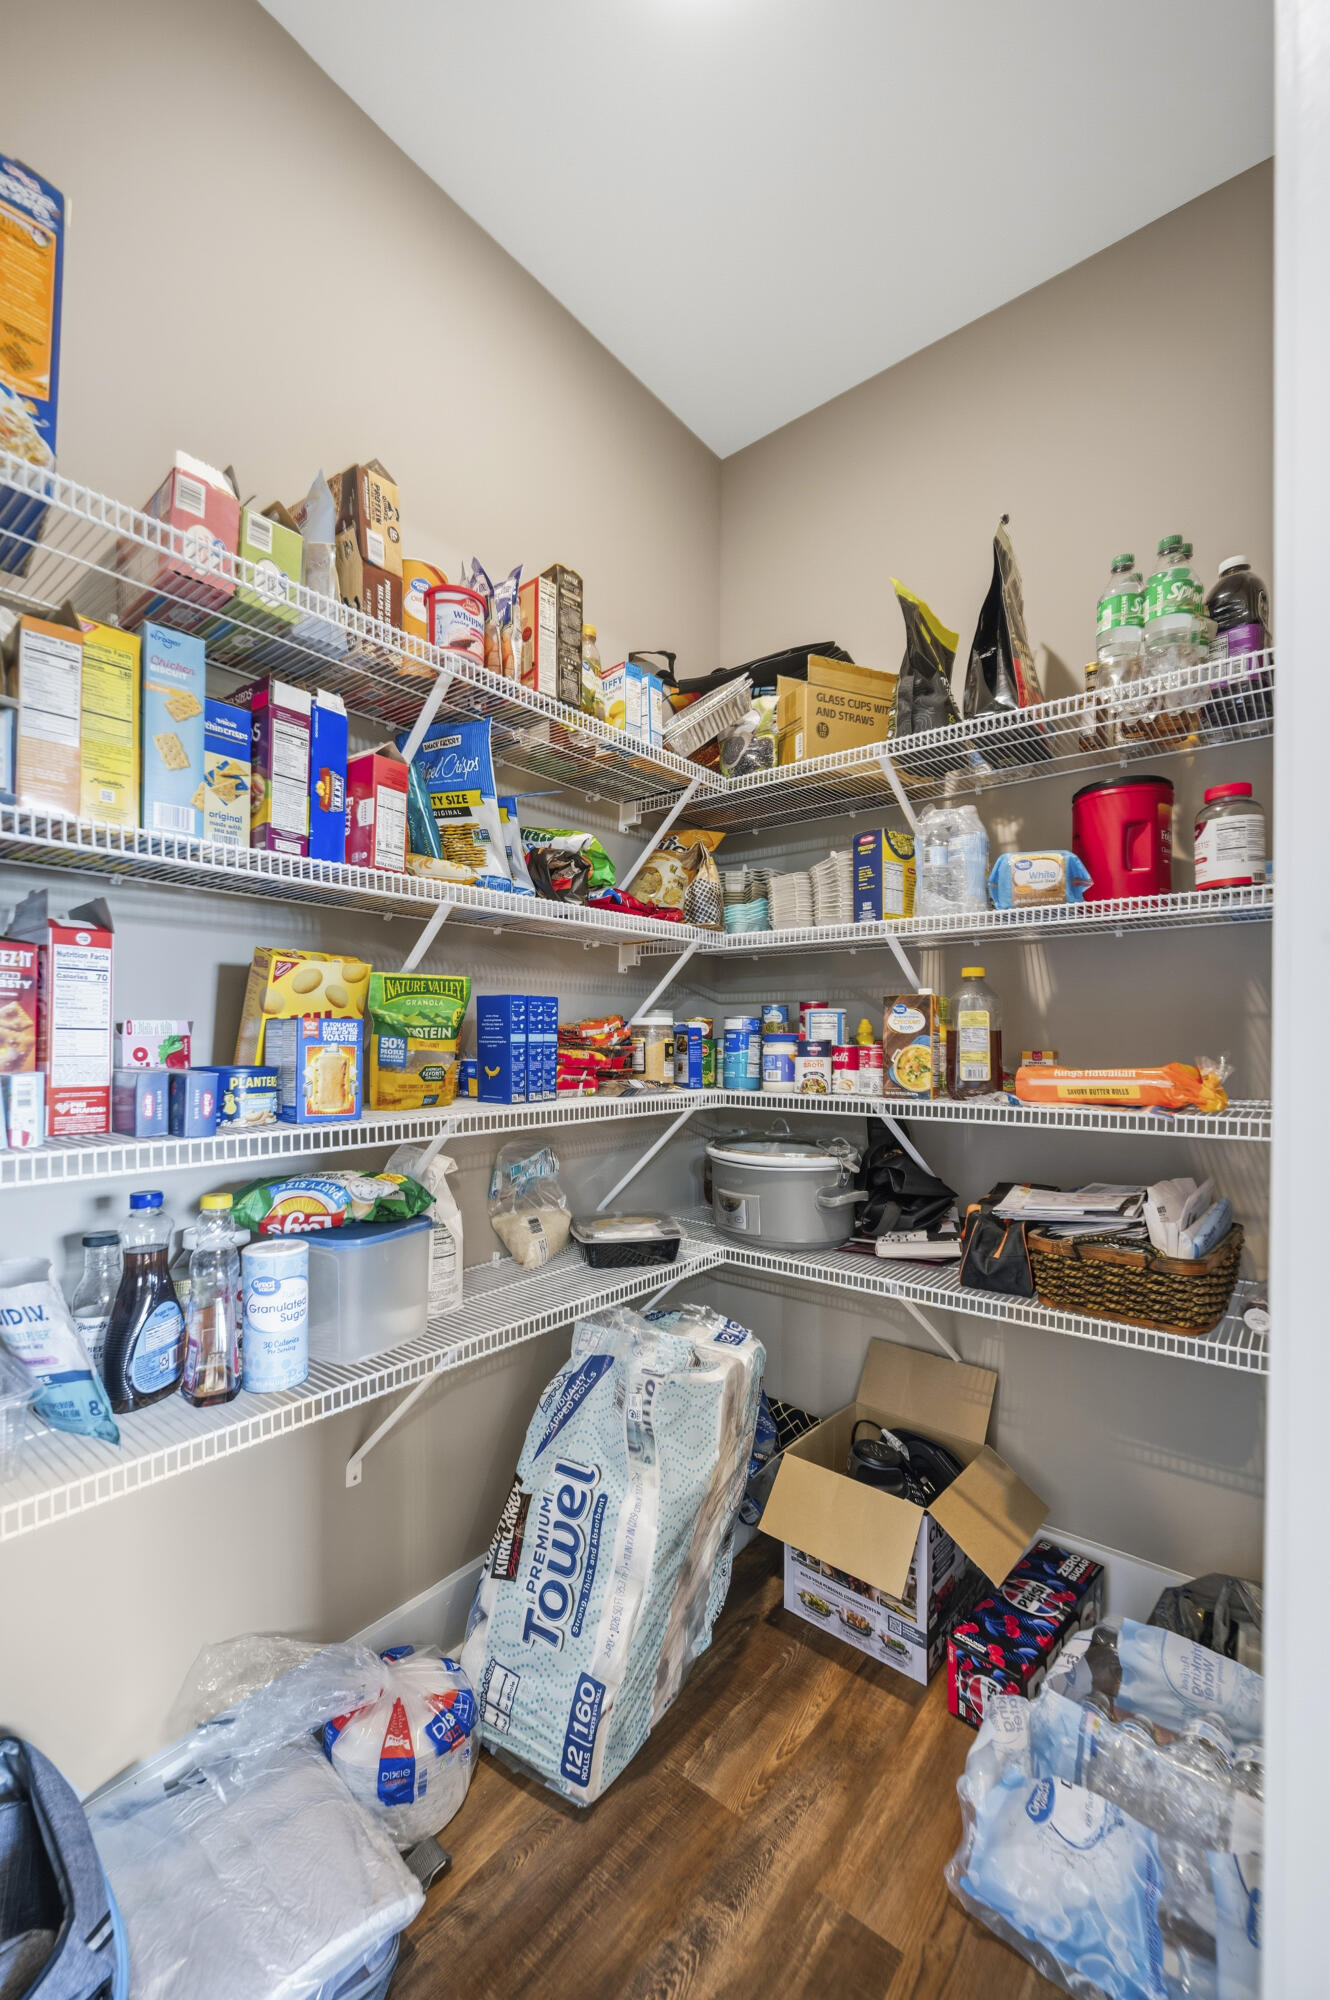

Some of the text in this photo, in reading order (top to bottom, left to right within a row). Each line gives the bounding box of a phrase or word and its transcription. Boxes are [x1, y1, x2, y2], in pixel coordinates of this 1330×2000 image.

[150, 655, 196, 676] Chicken
[816, 691, 890, 716] GLASS CUPS WIT
[815, 706, 875, 727] AND STRAWS
[441, 753, 480, 781] Crisps
[447, 793, 469, 806] SIZE
[208, 811, 243, 823] original
[434, 808, 462, 817] RIGINAL
[1029, 871, 1057, 880] White
[56, 950, 88, 959] Nutrition
[386, 980, 462, 999] NATURE VALLEY
[323, 1034, 357, 1042] TOASTER
[405, 1027, 452, 1038] PROTEIN
[381, 1037, 406, 1048] 50%
[1067, 1088, 1130, 1096] SAVORY BUTTER ROLLS
[249, 1297, 307, 1314] Granulated
[263, 1337, 300, 1349] 30 Calories
[573, 1370, 597, 1402] ROLLS
[525, 1496, 553, 1594] PREMIUM
[520, 1461, 599, 1649] Towel
[571, 1497, 606, 1634] Strong, Thick and Absorbent
[1057, 1553, 1082, 1577] ZERO
[1068, 1558, 1091, 1582] SUGAR
[564, 1681, 598, 1776] 12 160
[381, 1769, 411, 1782] Dixie
[580, 1752, 591, 1781] ROLLS
